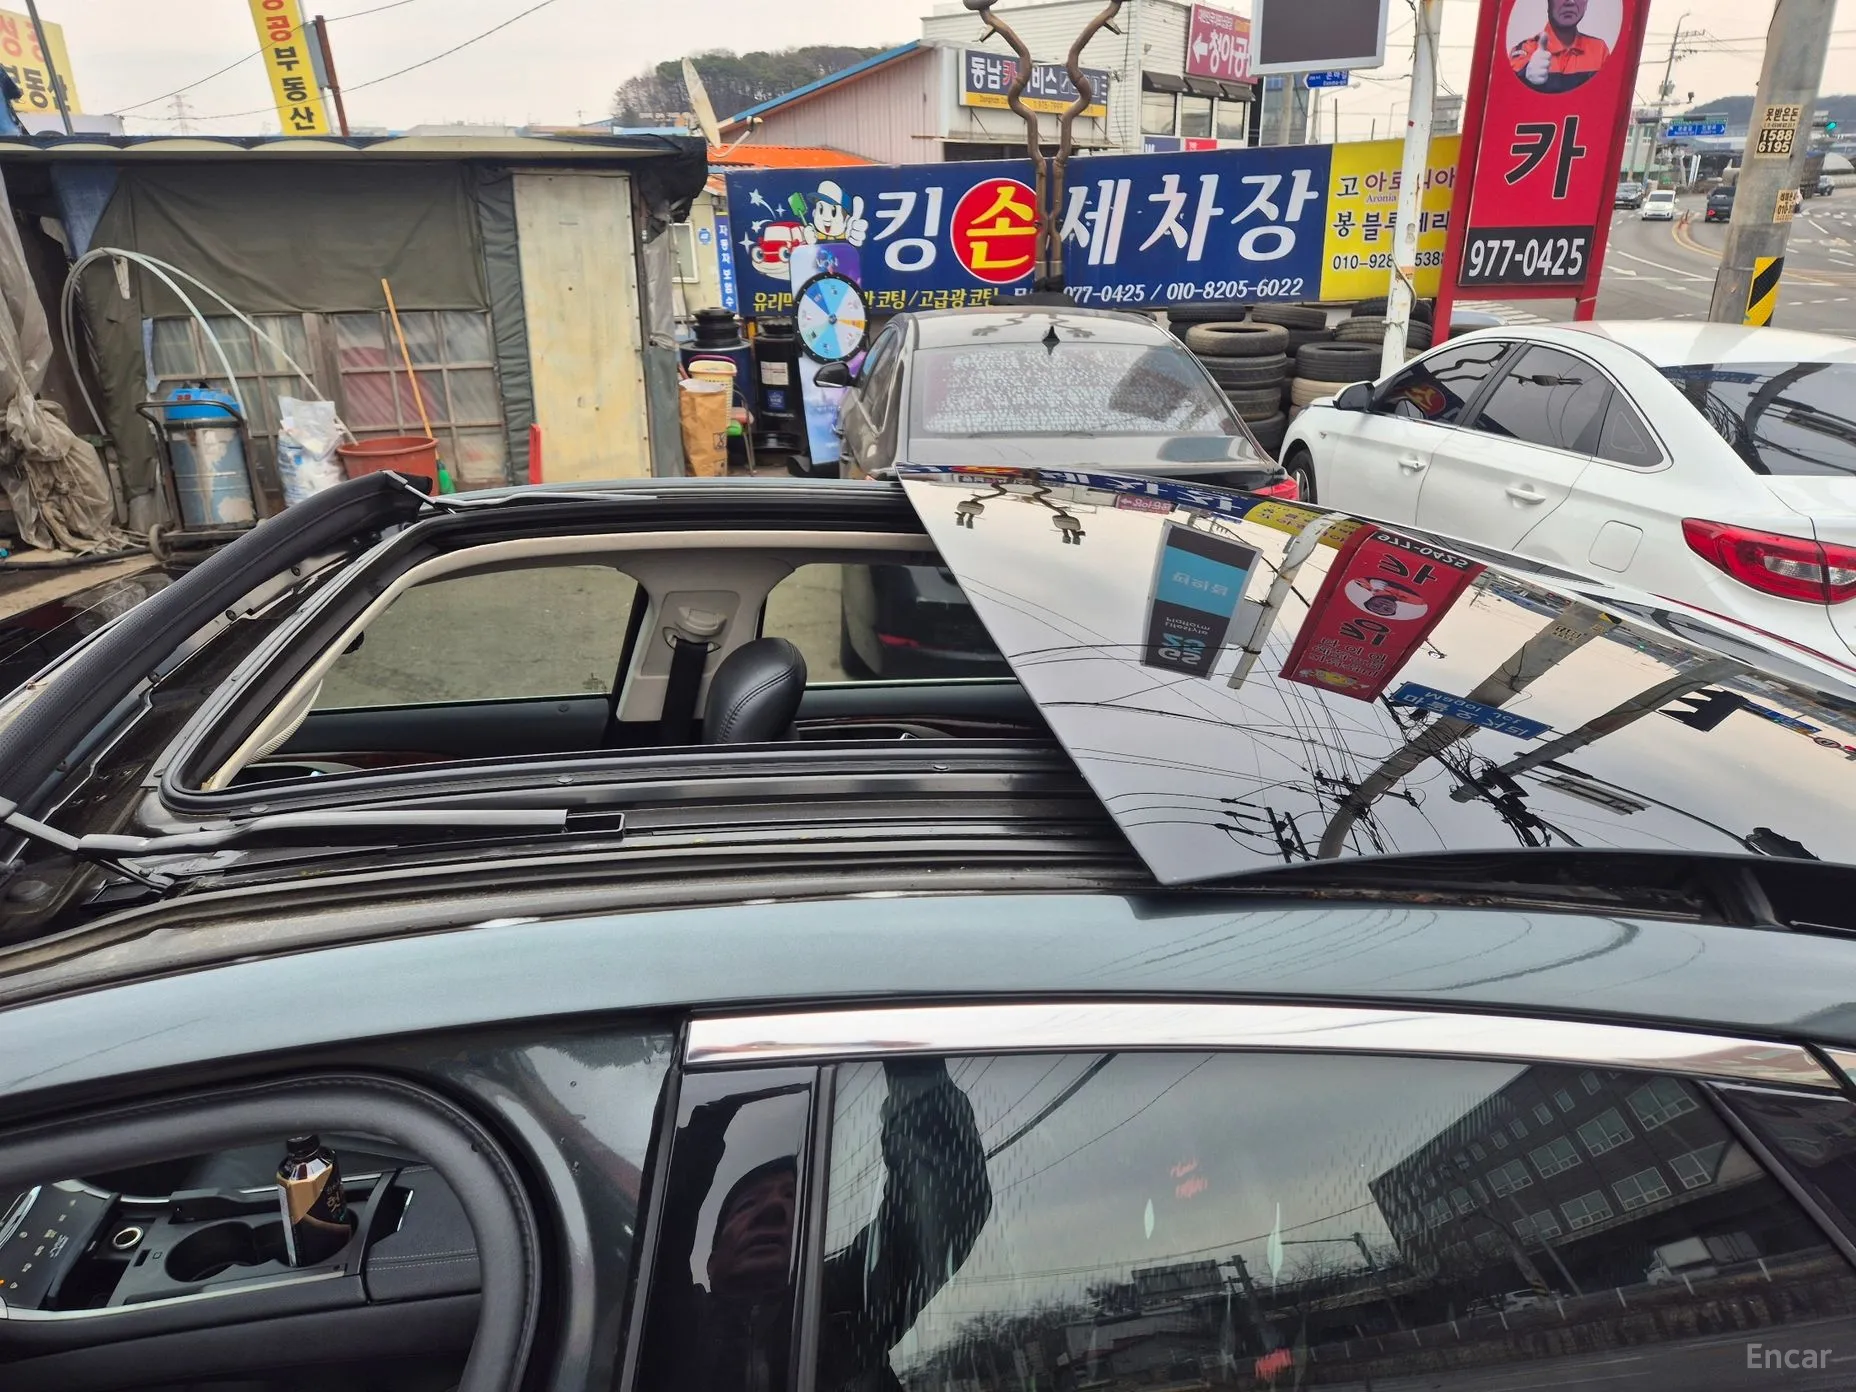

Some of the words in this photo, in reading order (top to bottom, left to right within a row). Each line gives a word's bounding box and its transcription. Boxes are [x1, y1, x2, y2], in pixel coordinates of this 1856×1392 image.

[971, 56, 1057, 94] 동남카비스
[1759, 141, 1790, 153] 6195
[1763, 129, 1793, 141] 1588
[1505, 115, 1587, 200] 카
[873, 187, 944, 271] 킹
[966, 186, 1037, 269] 손
[1468, 238, 1586, 277] 977-0425
[1167, 277, 1304, 301] 010-8205-6022
